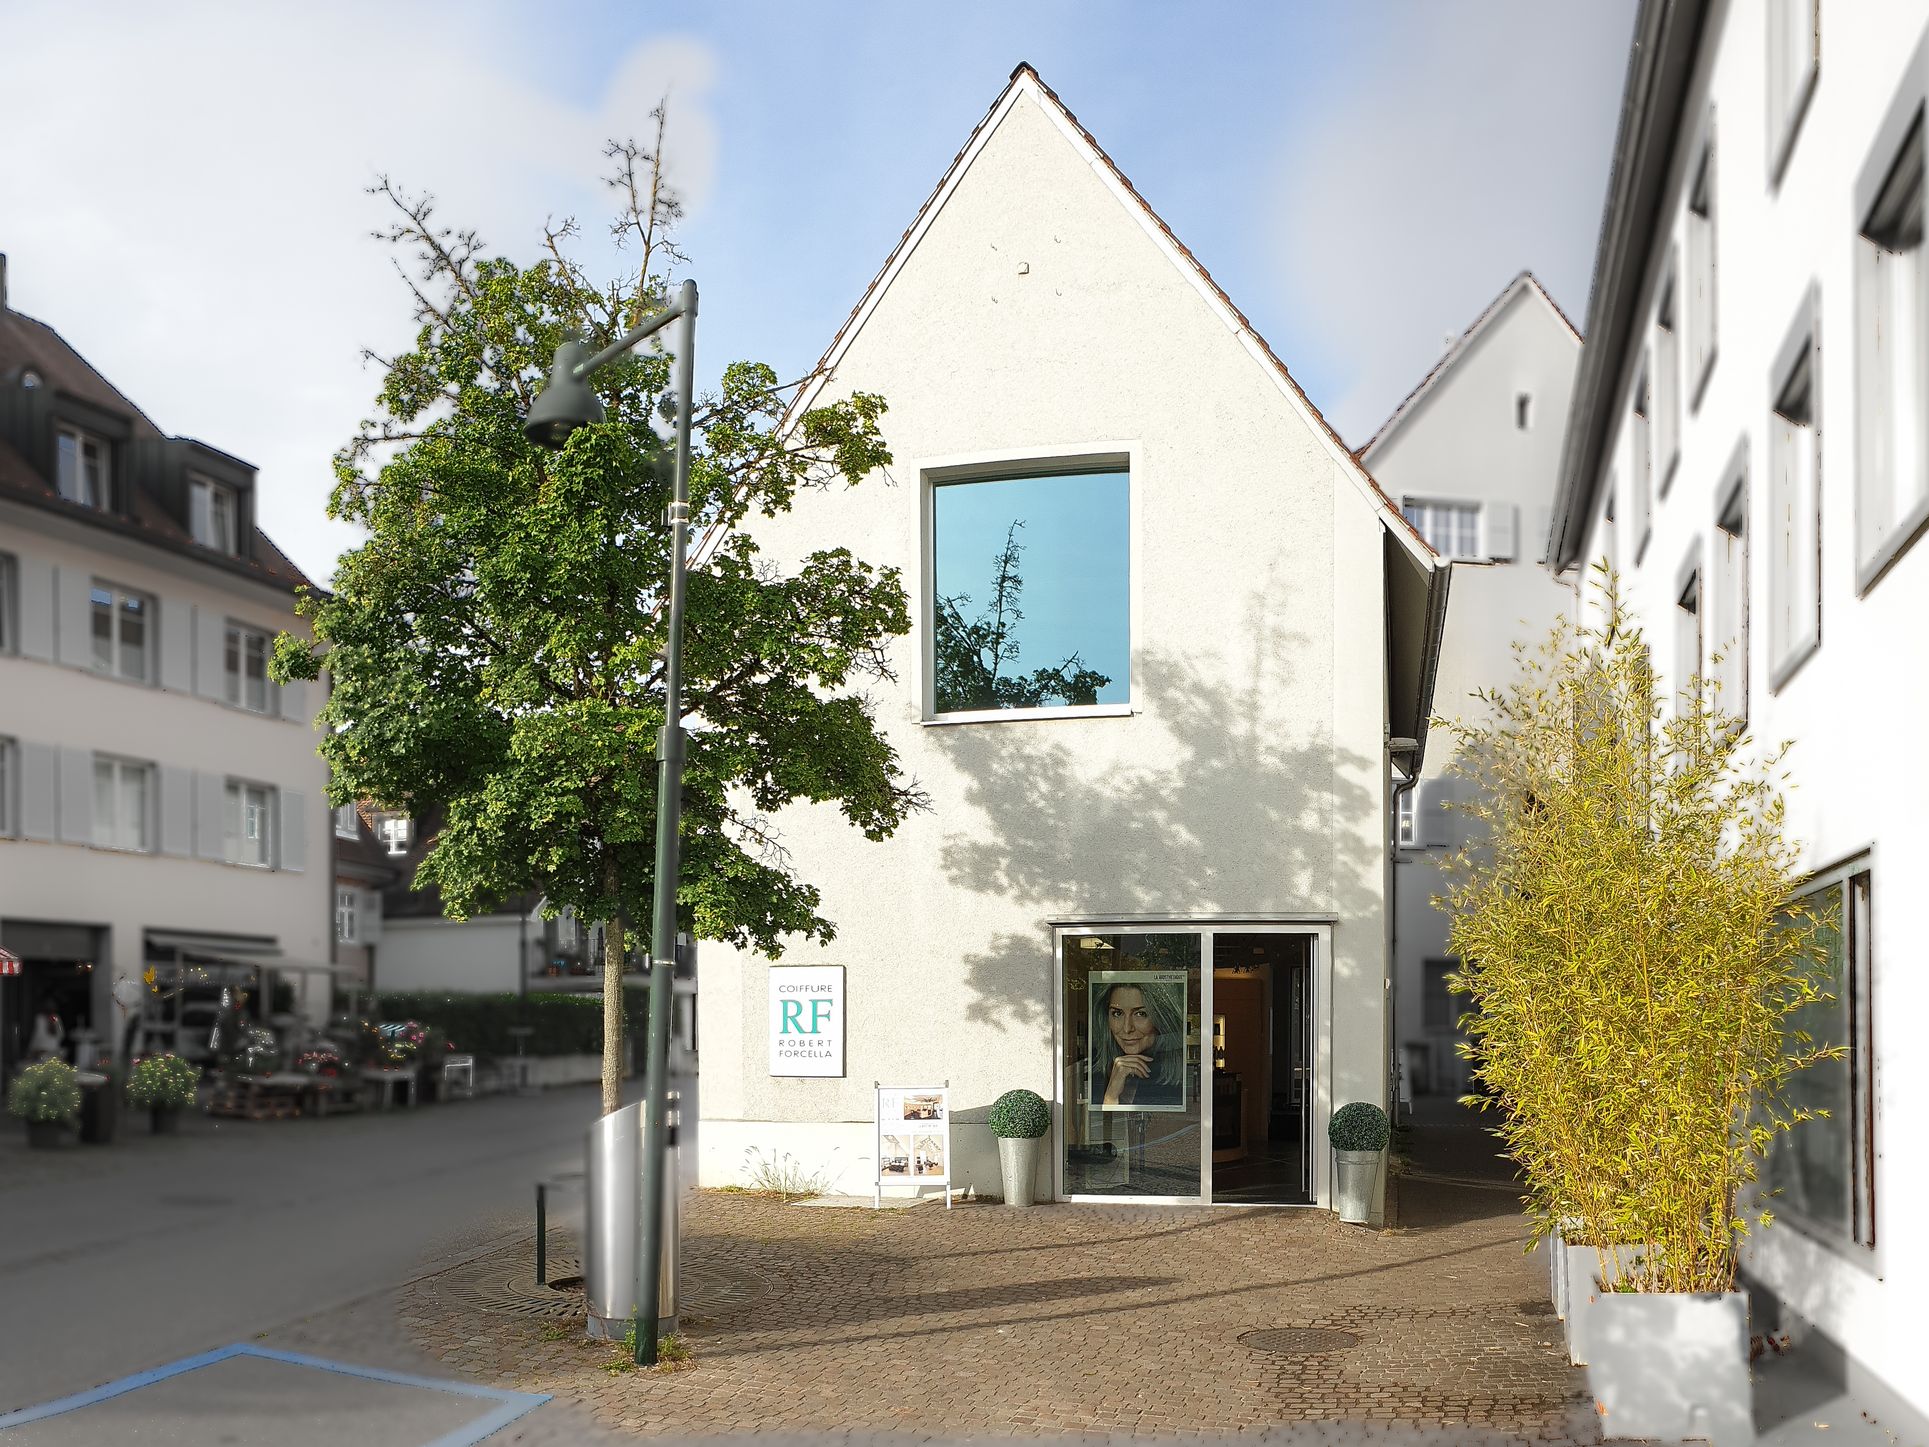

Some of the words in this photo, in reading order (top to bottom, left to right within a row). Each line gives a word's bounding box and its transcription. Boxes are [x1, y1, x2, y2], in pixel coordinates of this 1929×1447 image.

[779, 984, 832, 993] COIFFURE
[779, 999, 833, 1034] RF
[779, 1039, 832, 1048] ROBERT
[779, 1050, 832, 1058] FORCELLA
